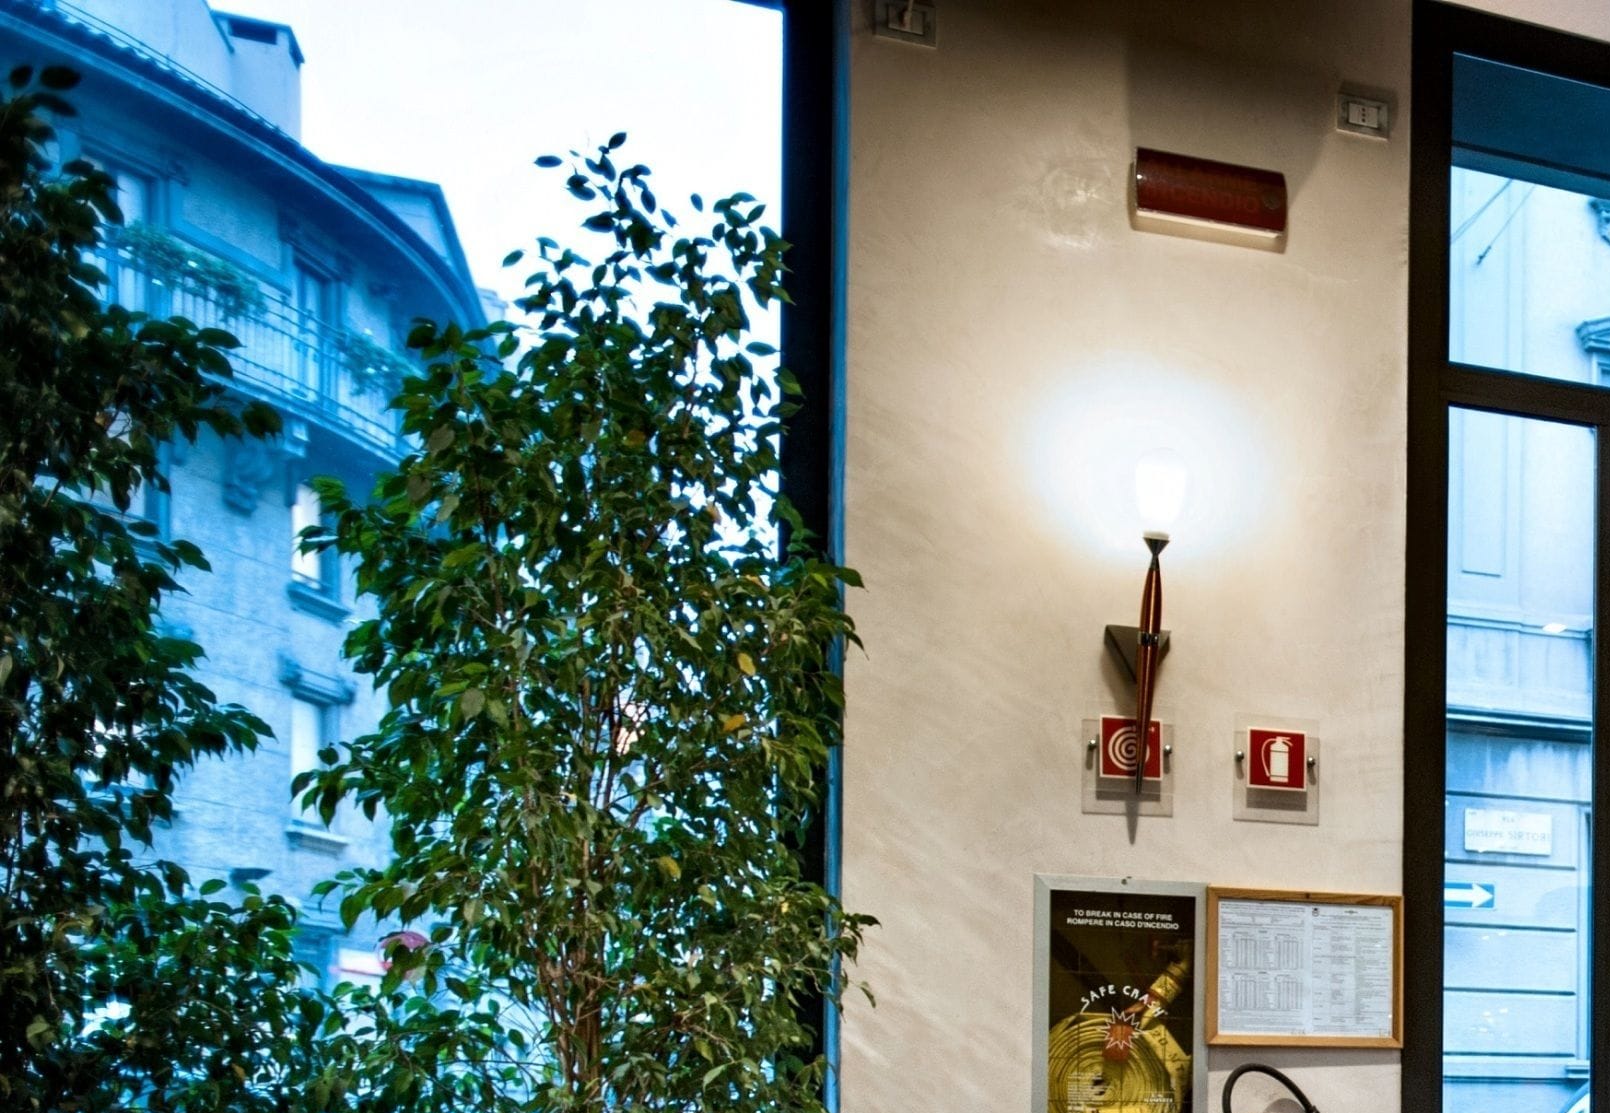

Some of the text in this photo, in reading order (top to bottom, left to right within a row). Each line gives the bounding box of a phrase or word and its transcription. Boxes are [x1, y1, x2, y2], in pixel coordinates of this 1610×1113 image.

[1074, 909, 1084, 917] TO
[1086, 910, 1112, 918] BREAK
[1122, 912, 1143, 920] CASE
[1156, 913, 1173, 921] FIRE
[1067, 917, 1103, 926] ROMPERE
[1114, 920, 1136, 928] CASO
[1137, 921, 1180, 930] D'INCENDIO
[1080, 984, 1165, 1018] SAFE CRASH
